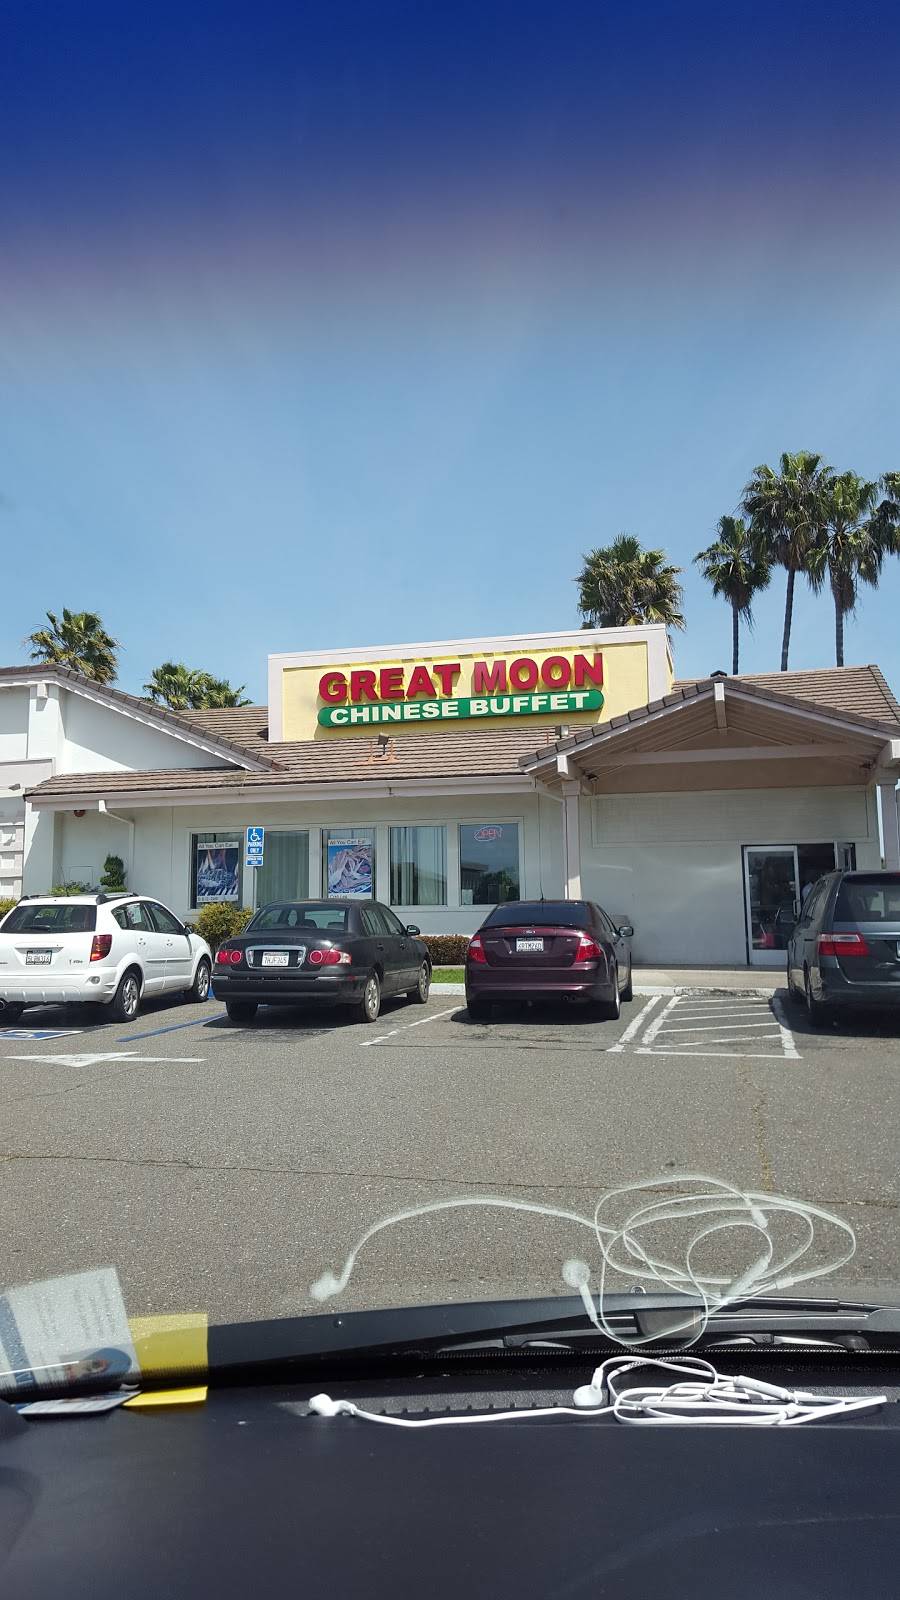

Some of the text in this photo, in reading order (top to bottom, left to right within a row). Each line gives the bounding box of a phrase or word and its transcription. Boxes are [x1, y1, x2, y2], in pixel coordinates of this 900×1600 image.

[319, 653, 604, 702] GREAT MOON
[330, 692, 590, 725] CHINESE BUFFET
